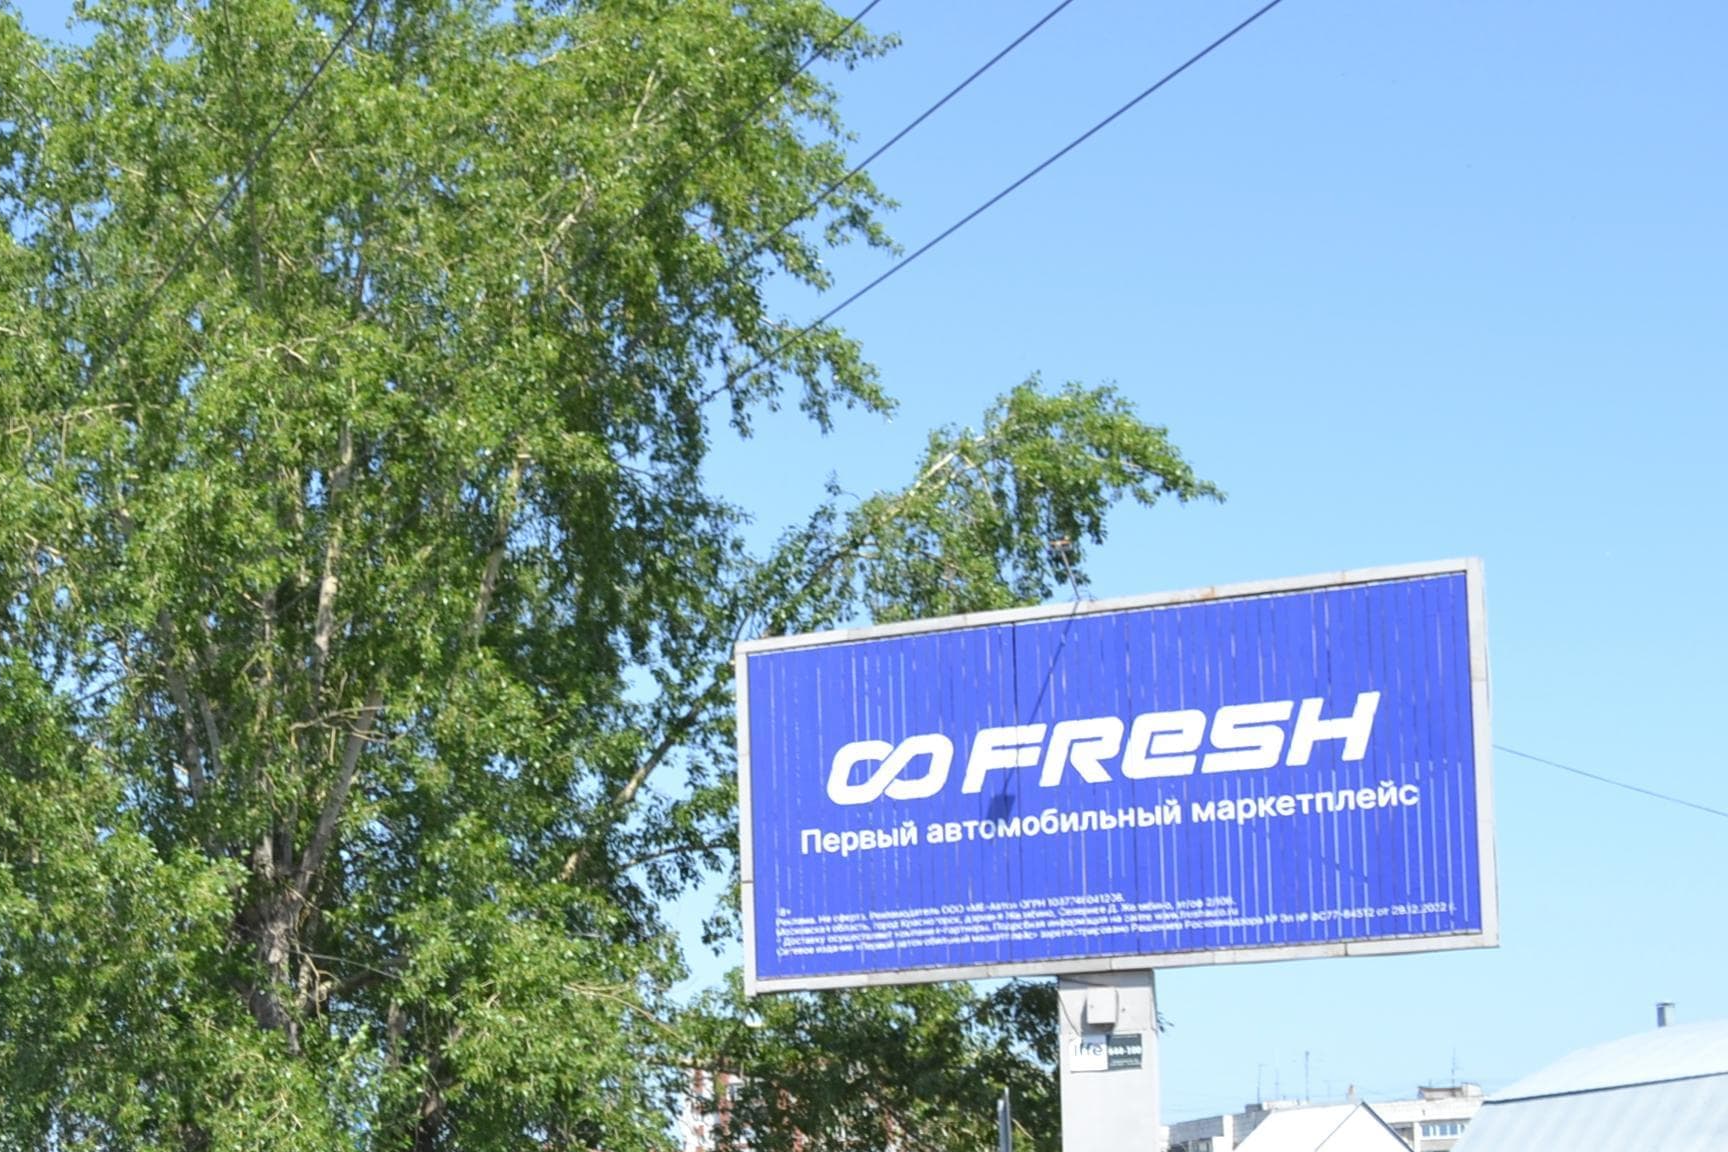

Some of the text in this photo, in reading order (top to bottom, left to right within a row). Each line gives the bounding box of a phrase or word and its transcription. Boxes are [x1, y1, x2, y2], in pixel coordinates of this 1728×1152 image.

[800, 779, 1421, 857] Первый автомобильный маркетплейс
